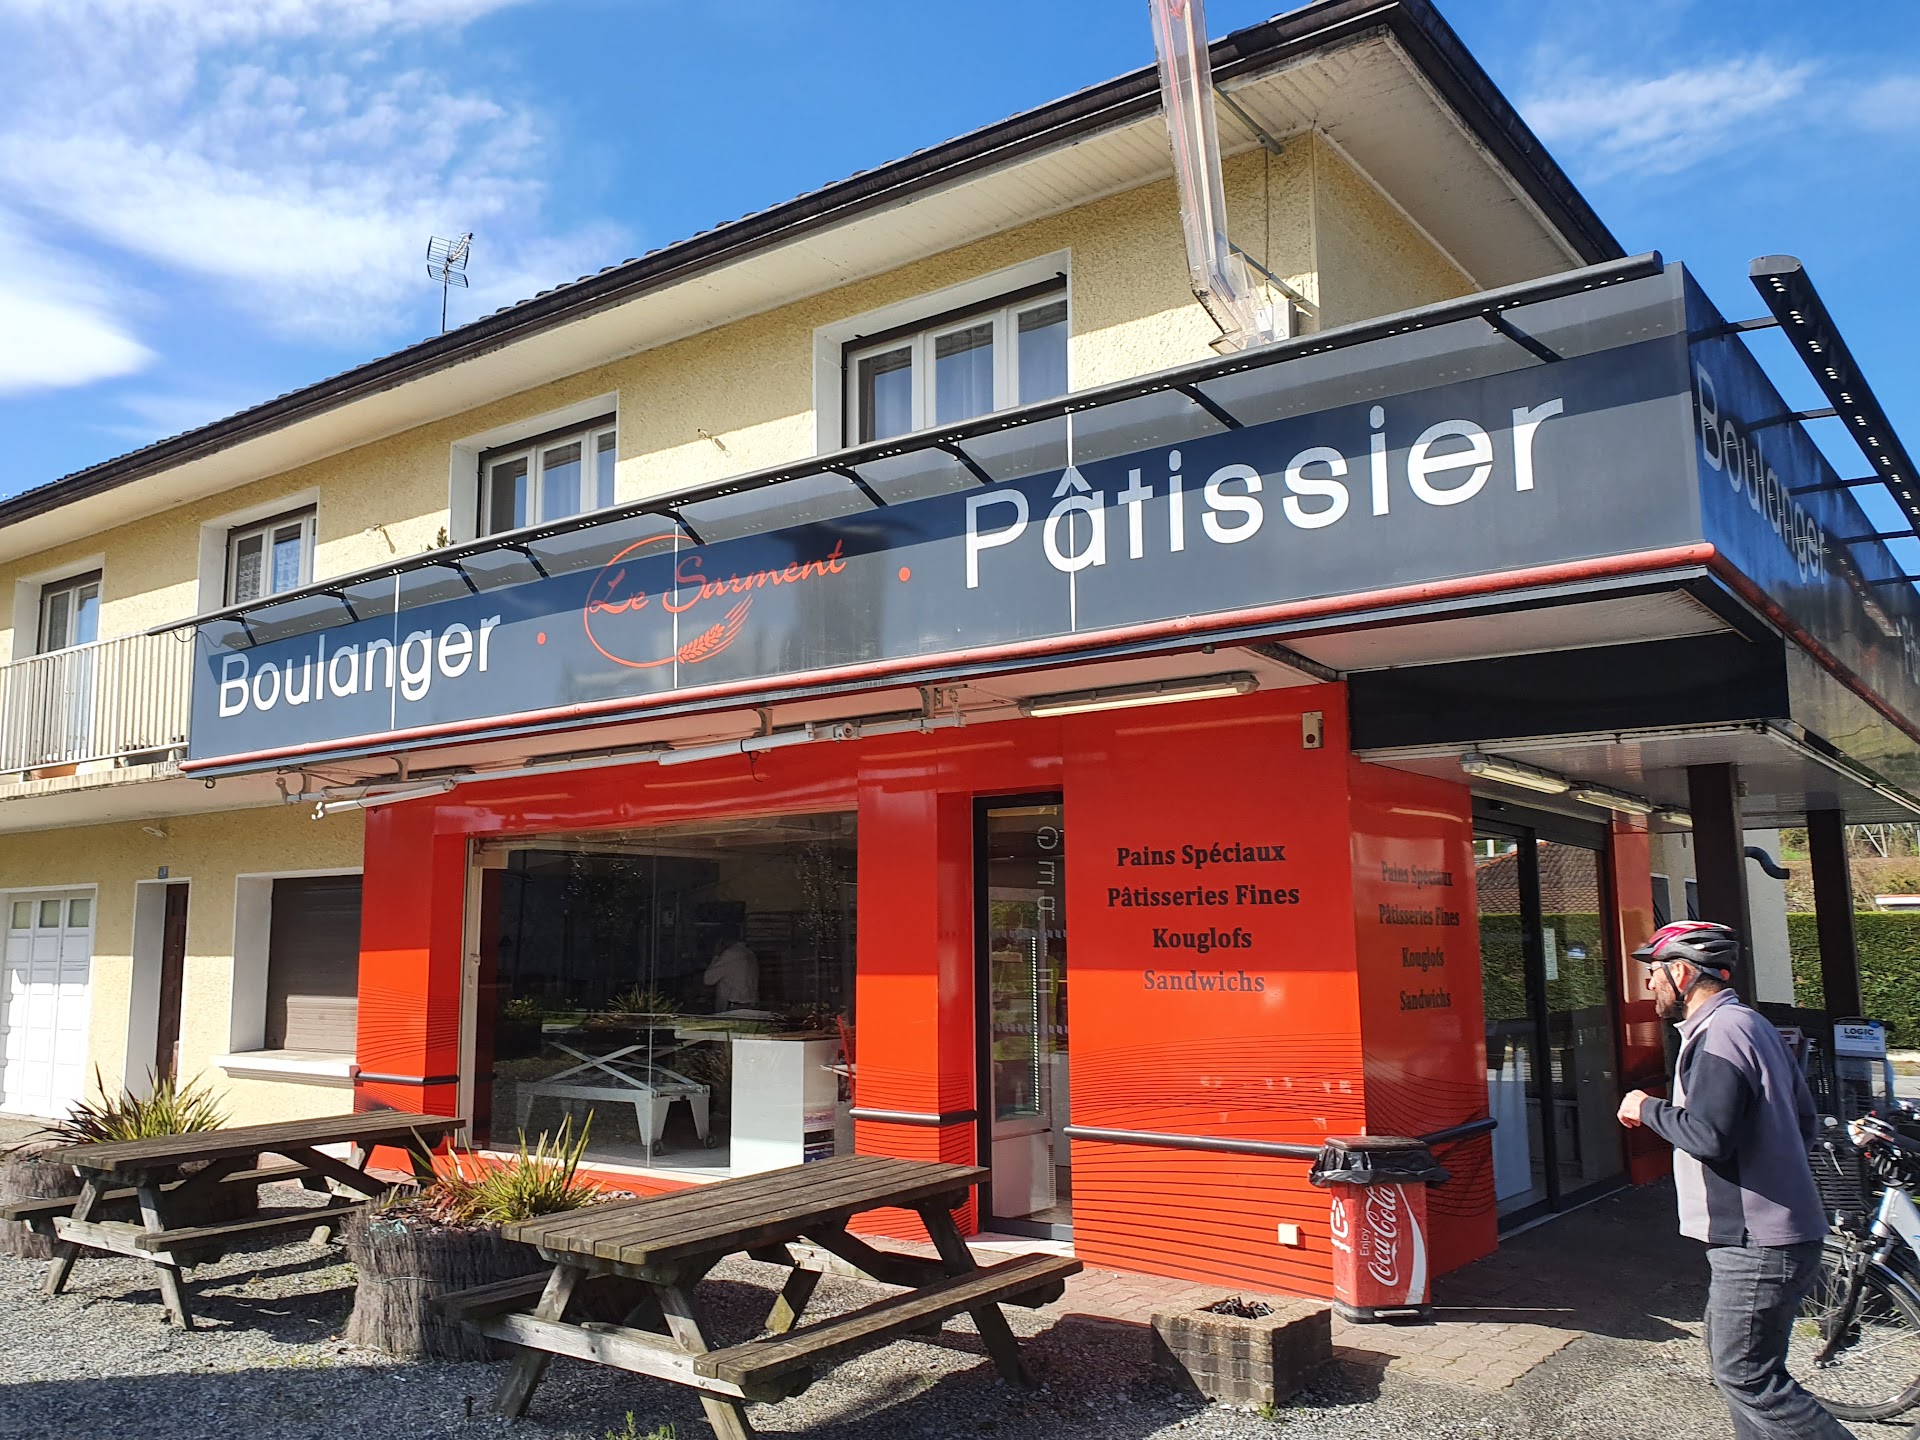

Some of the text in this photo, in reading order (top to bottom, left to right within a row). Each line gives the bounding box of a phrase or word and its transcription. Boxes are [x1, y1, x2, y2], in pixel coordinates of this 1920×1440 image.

[1697, 361, 1826, 585] Boulanger
[219, 398, 1564, 718] Boulanger Le Sarment Pâtissier
[1117, 842, 1286, 869] Pains Spéciaux
[1381, 860, 1409, 883] Pains
[1107, 884, 1300, 907] Pâtisseries Fines
[1378, 903, 1460, 926] Pâtisseries Fines
[1152, 927, 1252, 954] Kouglofs
[1402, 945, 1445, 972] Kouglofs
[1143, 969, 1265, 992] Sandwichs
[1400, 987, 1451, 1011] Sandwichs
[1844, 1027, 1874, 1036] LOGIC
[1360, 1228, 1371, 1256] Enjoy
